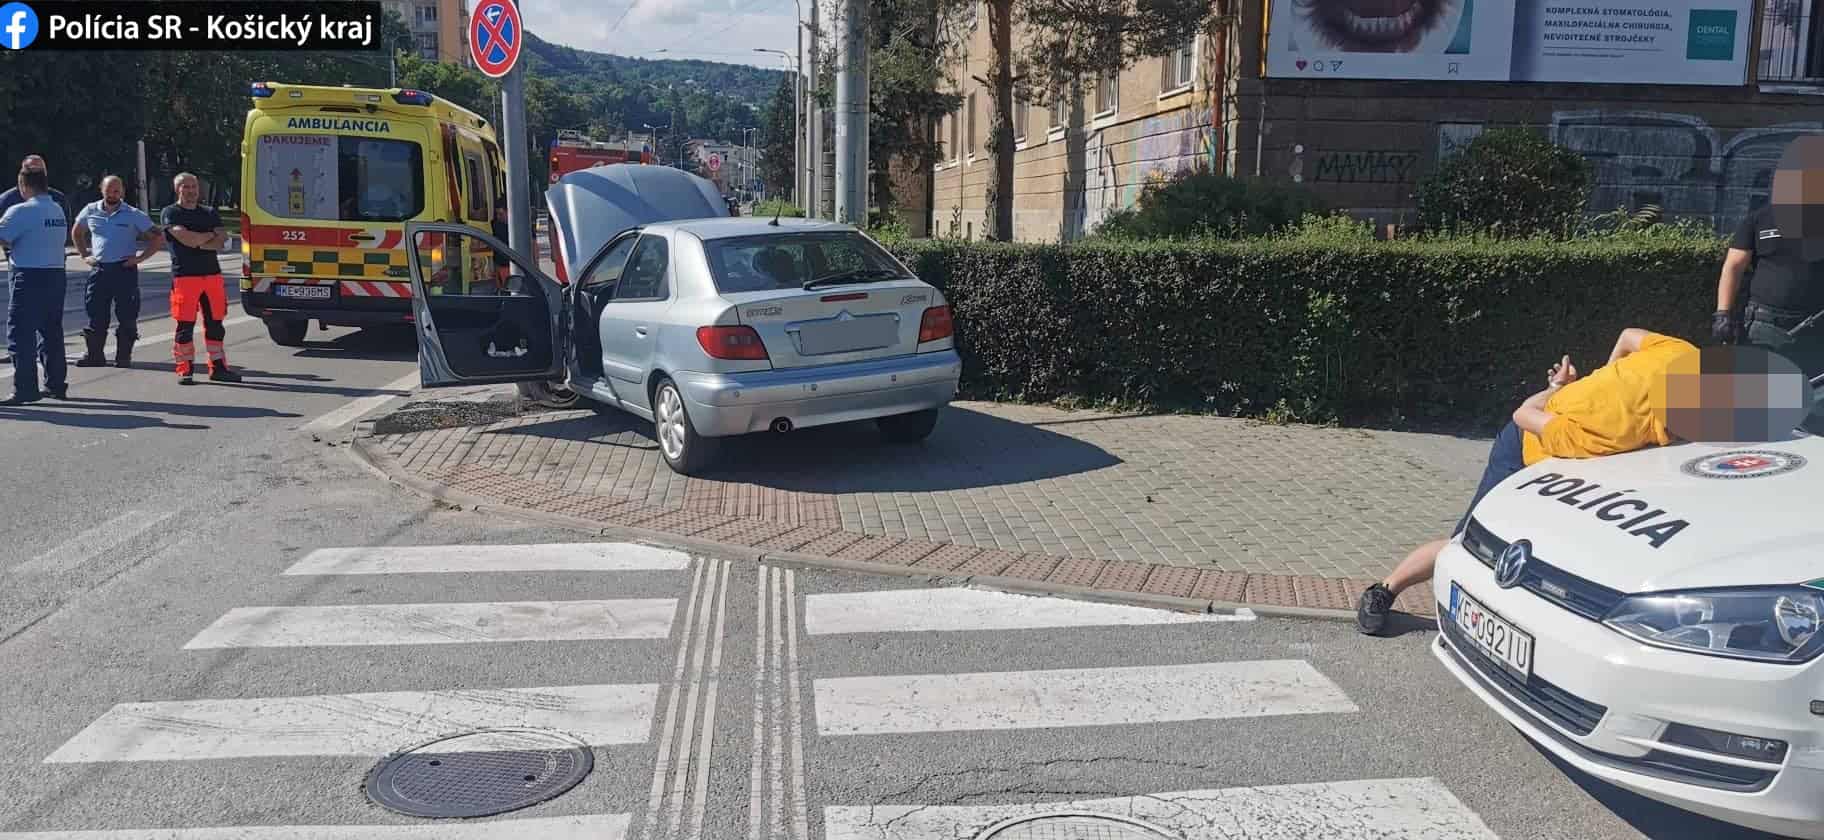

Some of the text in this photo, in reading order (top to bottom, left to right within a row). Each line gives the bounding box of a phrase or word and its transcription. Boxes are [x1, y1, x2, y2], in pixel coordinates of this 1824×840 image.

[287, 117, 390, 133] AMBULANCIA
[282, 230, 306, 241] 252
[1516, 472, 1691, 550] POLÍCIA
[1456, 597, 1472, 631] KE
